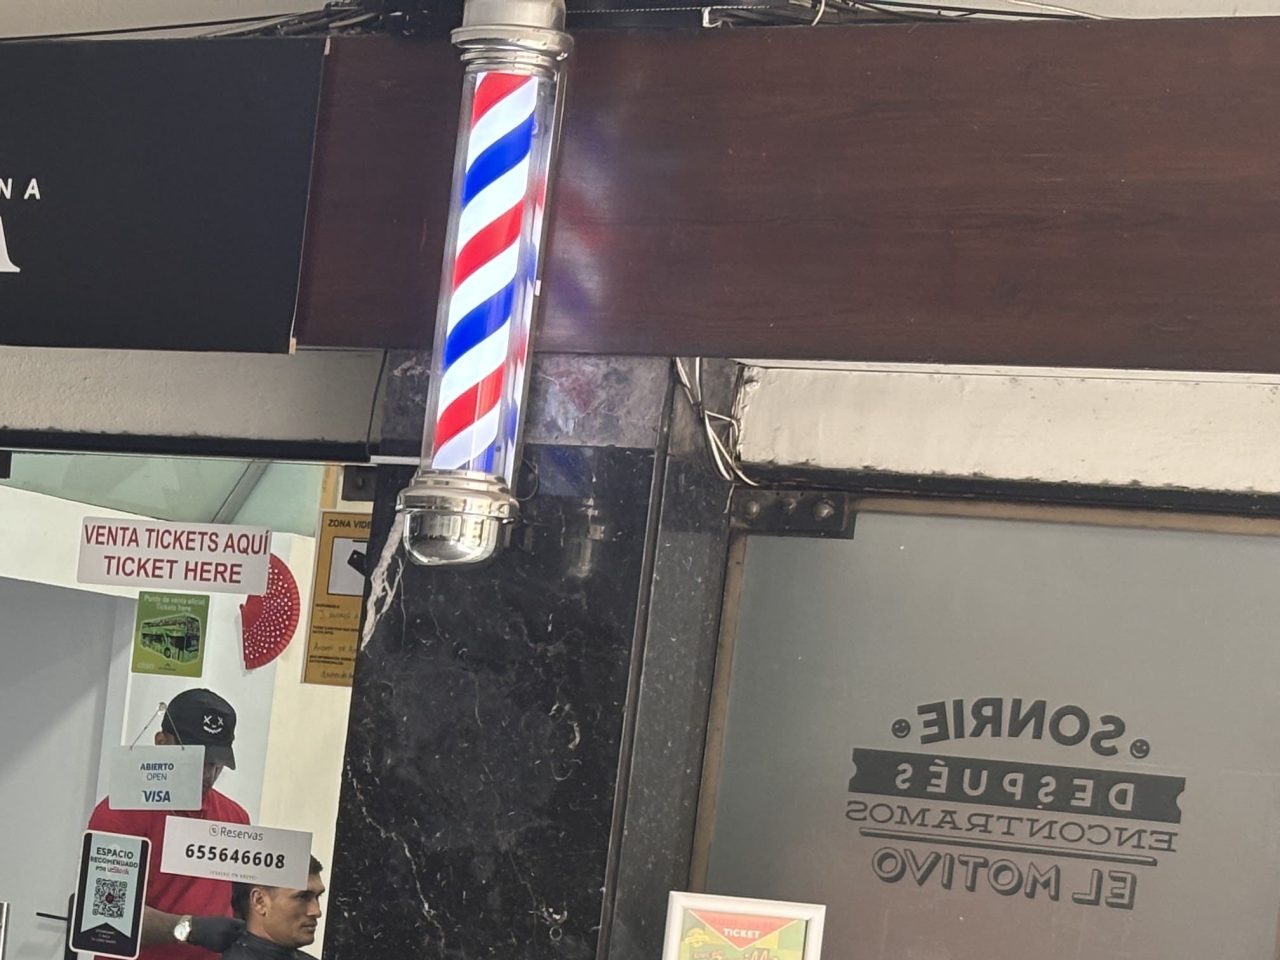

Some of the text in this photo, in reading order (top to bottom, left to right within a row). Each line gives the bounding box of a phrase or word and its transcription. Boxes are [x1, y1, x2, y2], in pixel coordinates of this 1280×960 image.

[328, 519, 351, 528] ZONA
[85, 524, 269, 556] VENTA TICKETS AQUÍ
[104, 555, 243, 584] TICKET HERE
[140, 763, 174, 771] ABIERTO
[142, 790, 171, 802] VISA
[220, 827, 263, 841] Reservas
[96, 847, 134, 859] ESPACIO
[185, 844, 285, 869] 655646608
[723, 928, 761, 939] TICKET
